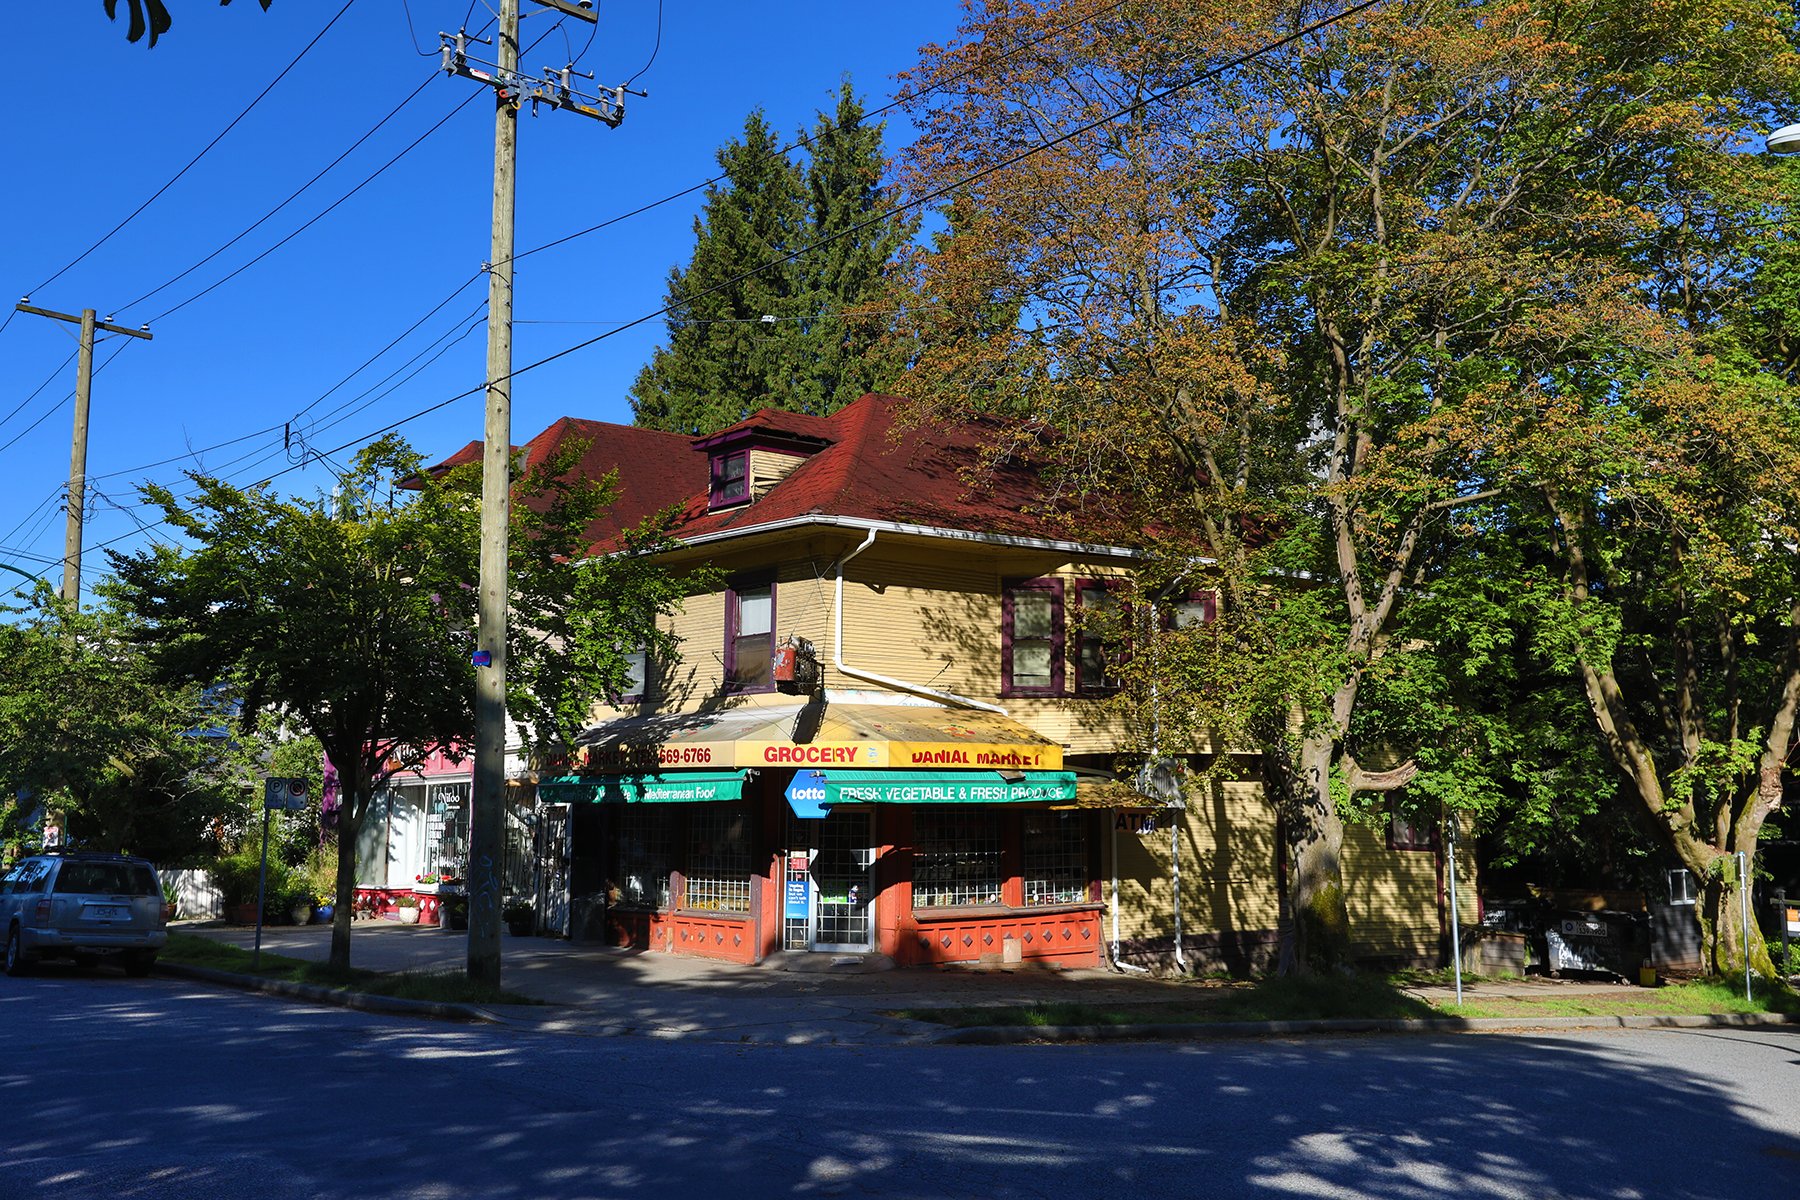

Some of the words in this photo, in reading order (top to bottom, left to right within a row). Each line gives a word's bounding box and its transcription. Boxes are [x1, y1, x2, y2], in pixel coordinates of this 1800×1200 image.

[764, 746, 858, 763] GROCERY
[273, 782, 280, 790] P
[695, 786, 716, 799] Food
[437, 792, 460, 804] Niloo
[791, 787, 826, 800] lotto
[839, 786, 882, 801] FRESH
[885, 786, 955, 801] VEGETABLE
[958, 786, 967, 800] &
[970, 786, 1008, 800] FRESH
[1115, 813, 1156, 831] ATM
